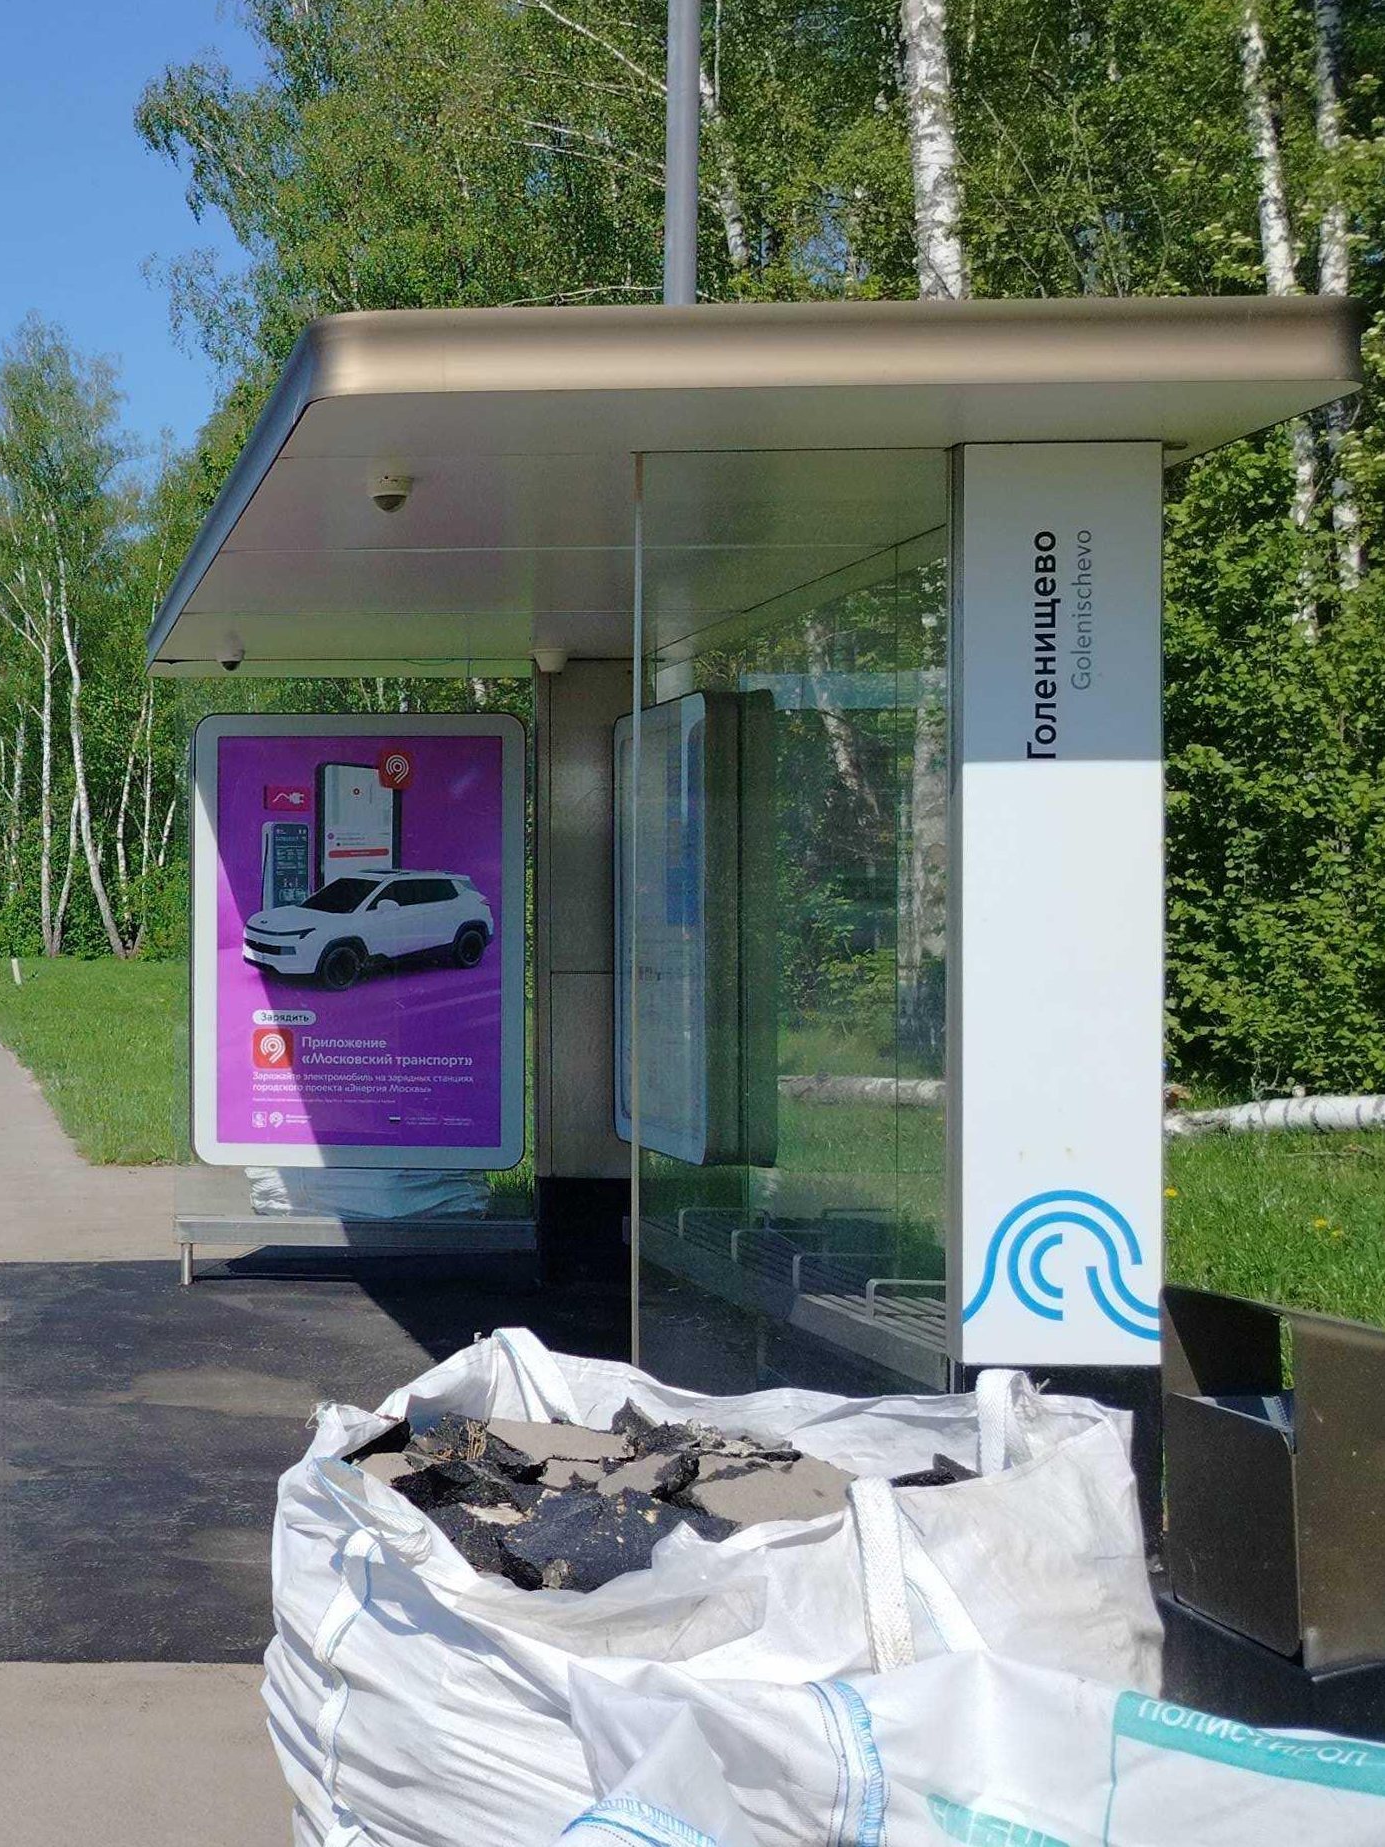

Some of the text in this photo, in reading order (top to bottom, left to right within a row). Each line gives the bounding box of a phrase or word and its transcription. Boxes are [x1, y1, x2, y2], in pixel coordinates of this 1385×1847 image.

[1070, 529, 1092, 690] Golenischevo
[1026, 530, 1061, 759] Голенищево
[261, 1012, 310, 1023] Зарядить
[301, 1036, 387, 1049] Приложение
[301, 1052, 473, 1067] «Московский транспорт»
[252, 1083, 303, 1093] городского
[305, 1085, 342, 1094] проекта
